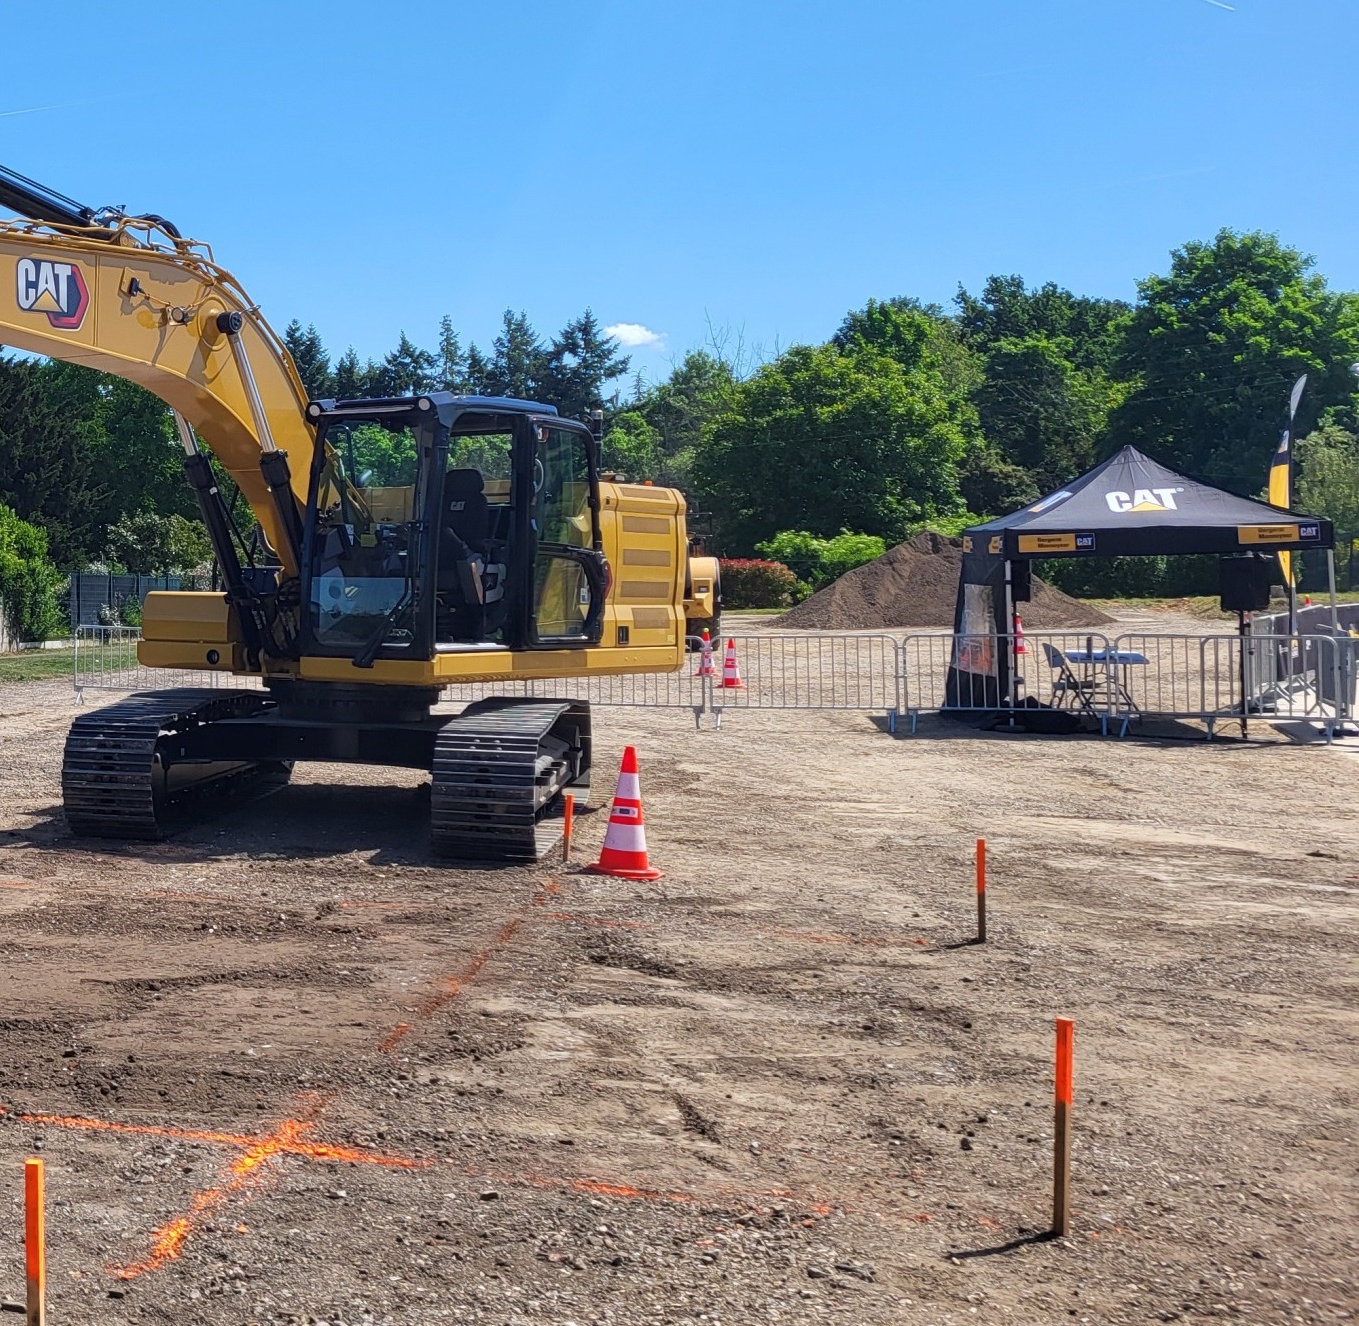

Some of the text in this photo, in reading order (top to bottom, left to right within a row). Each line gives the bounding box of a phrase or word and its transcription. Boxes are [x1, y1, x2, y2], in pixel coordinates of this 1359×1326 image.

[18, 258, 71, 313] CAT
[1105, 488, 1178, 513] CAT
[1300, 527, 1318, 536] CAT
[1076, 537, 1093, 546] CAT
